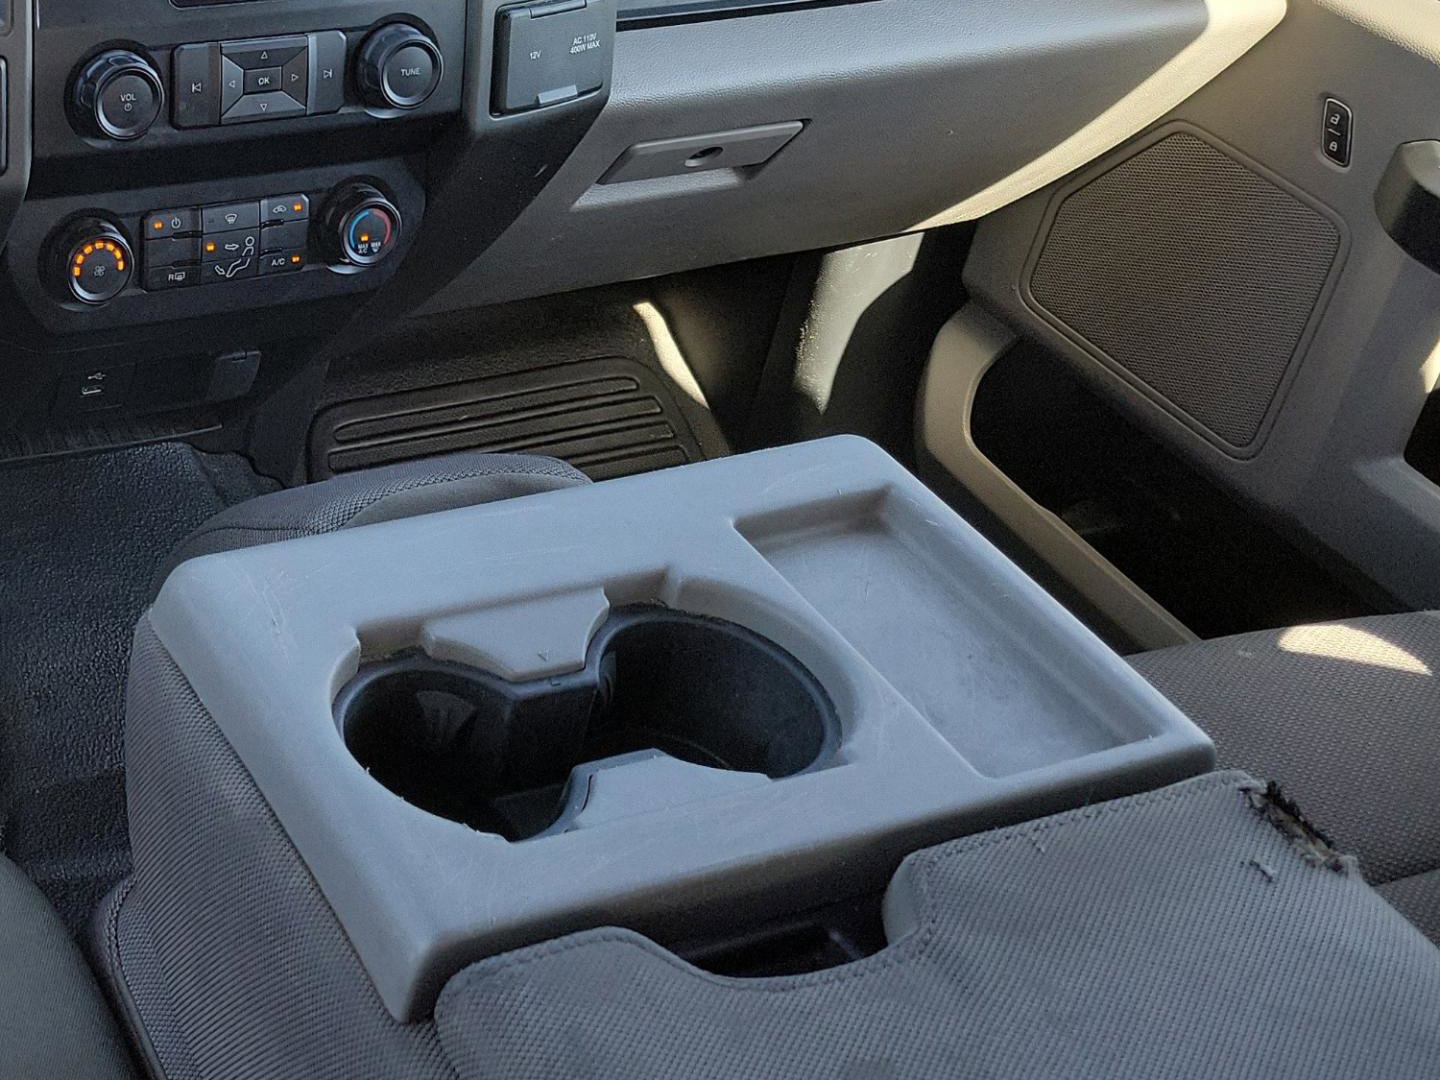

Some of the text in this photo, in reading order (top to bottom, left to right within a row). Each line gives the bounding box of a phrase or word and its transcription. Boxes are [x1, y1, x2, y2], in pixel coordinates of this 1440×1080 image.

[400, 67, 421, 77] TUNE
[258, 76, 270, 86] OK
[120, 93, 136, 102] VOL
[271, 258, 285, 266] A/C
